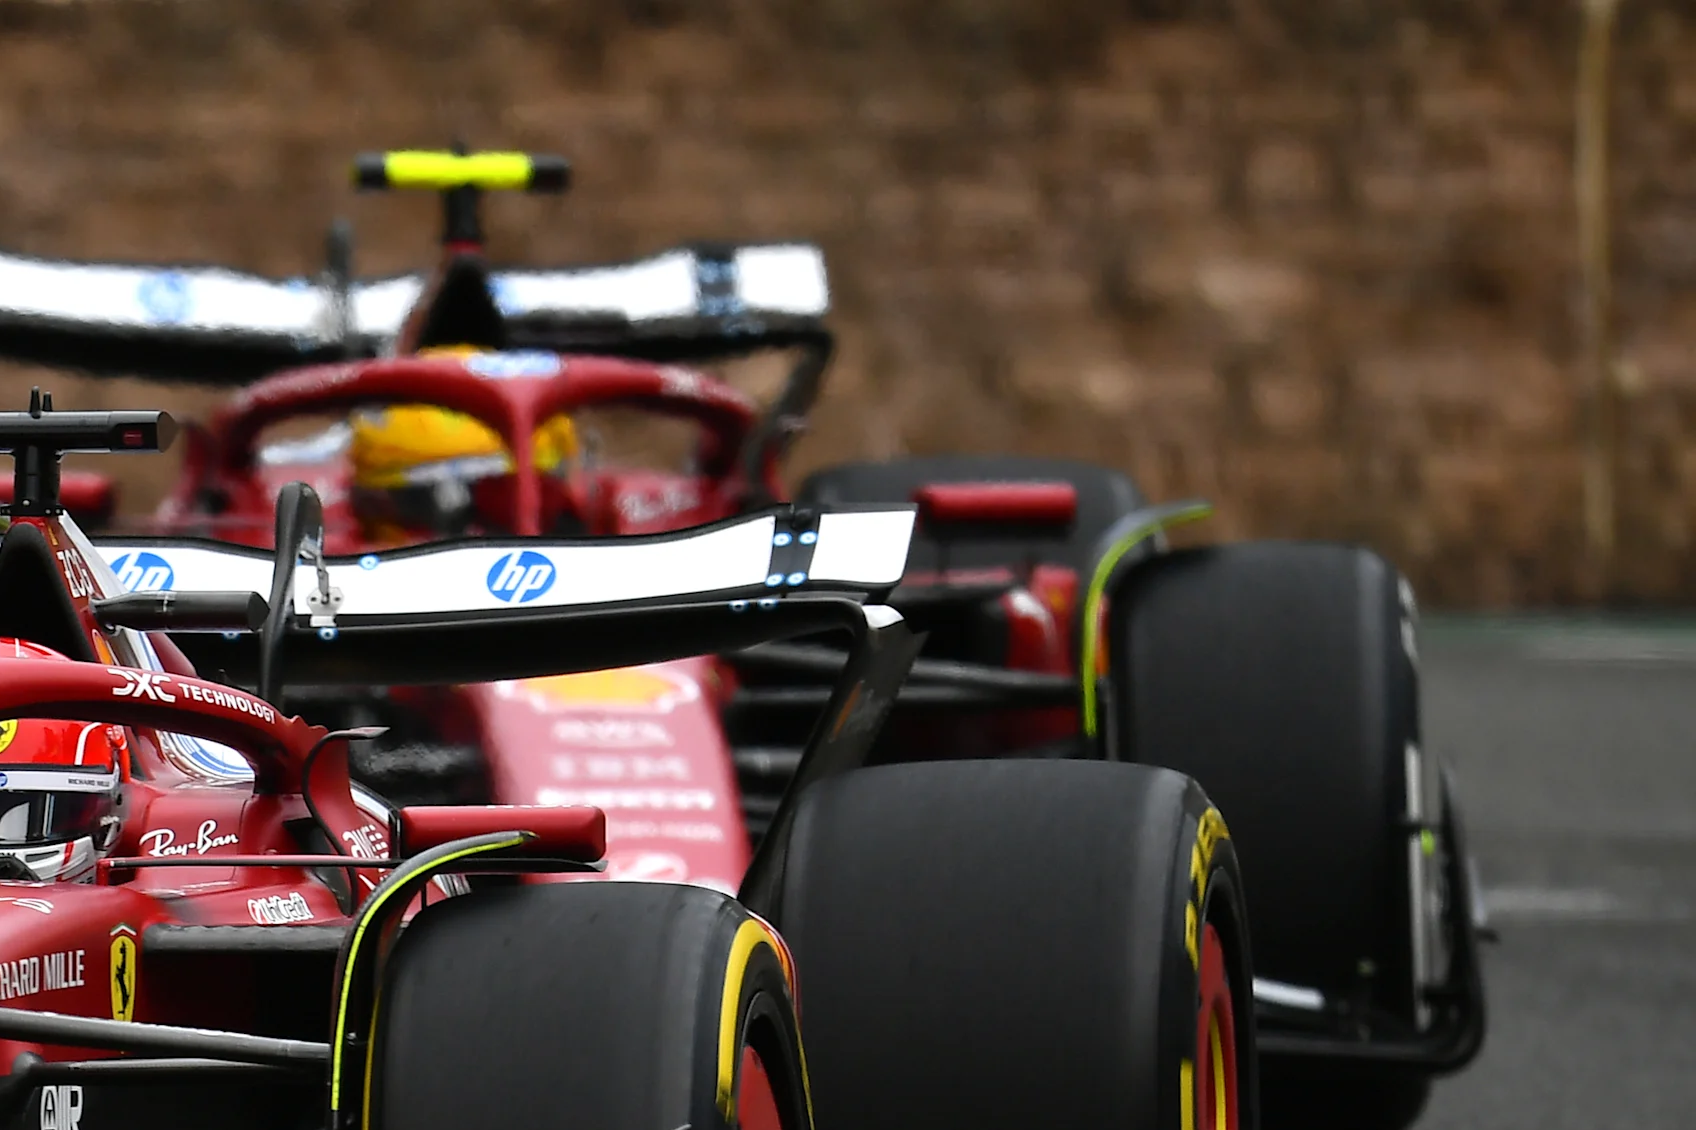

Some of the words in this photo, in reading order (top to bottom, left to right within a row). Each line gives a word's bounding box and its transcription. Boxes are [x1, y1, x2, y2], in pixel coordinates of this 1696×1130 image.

[491, 549, 553, 602] hp
[108, 668, 175, 702] DXC
[178, 683, 276, 724] TECHNOLOGY
[140, 819, 239, 856] Ray-Ban
[44, 950, 84, 991] MILLE
